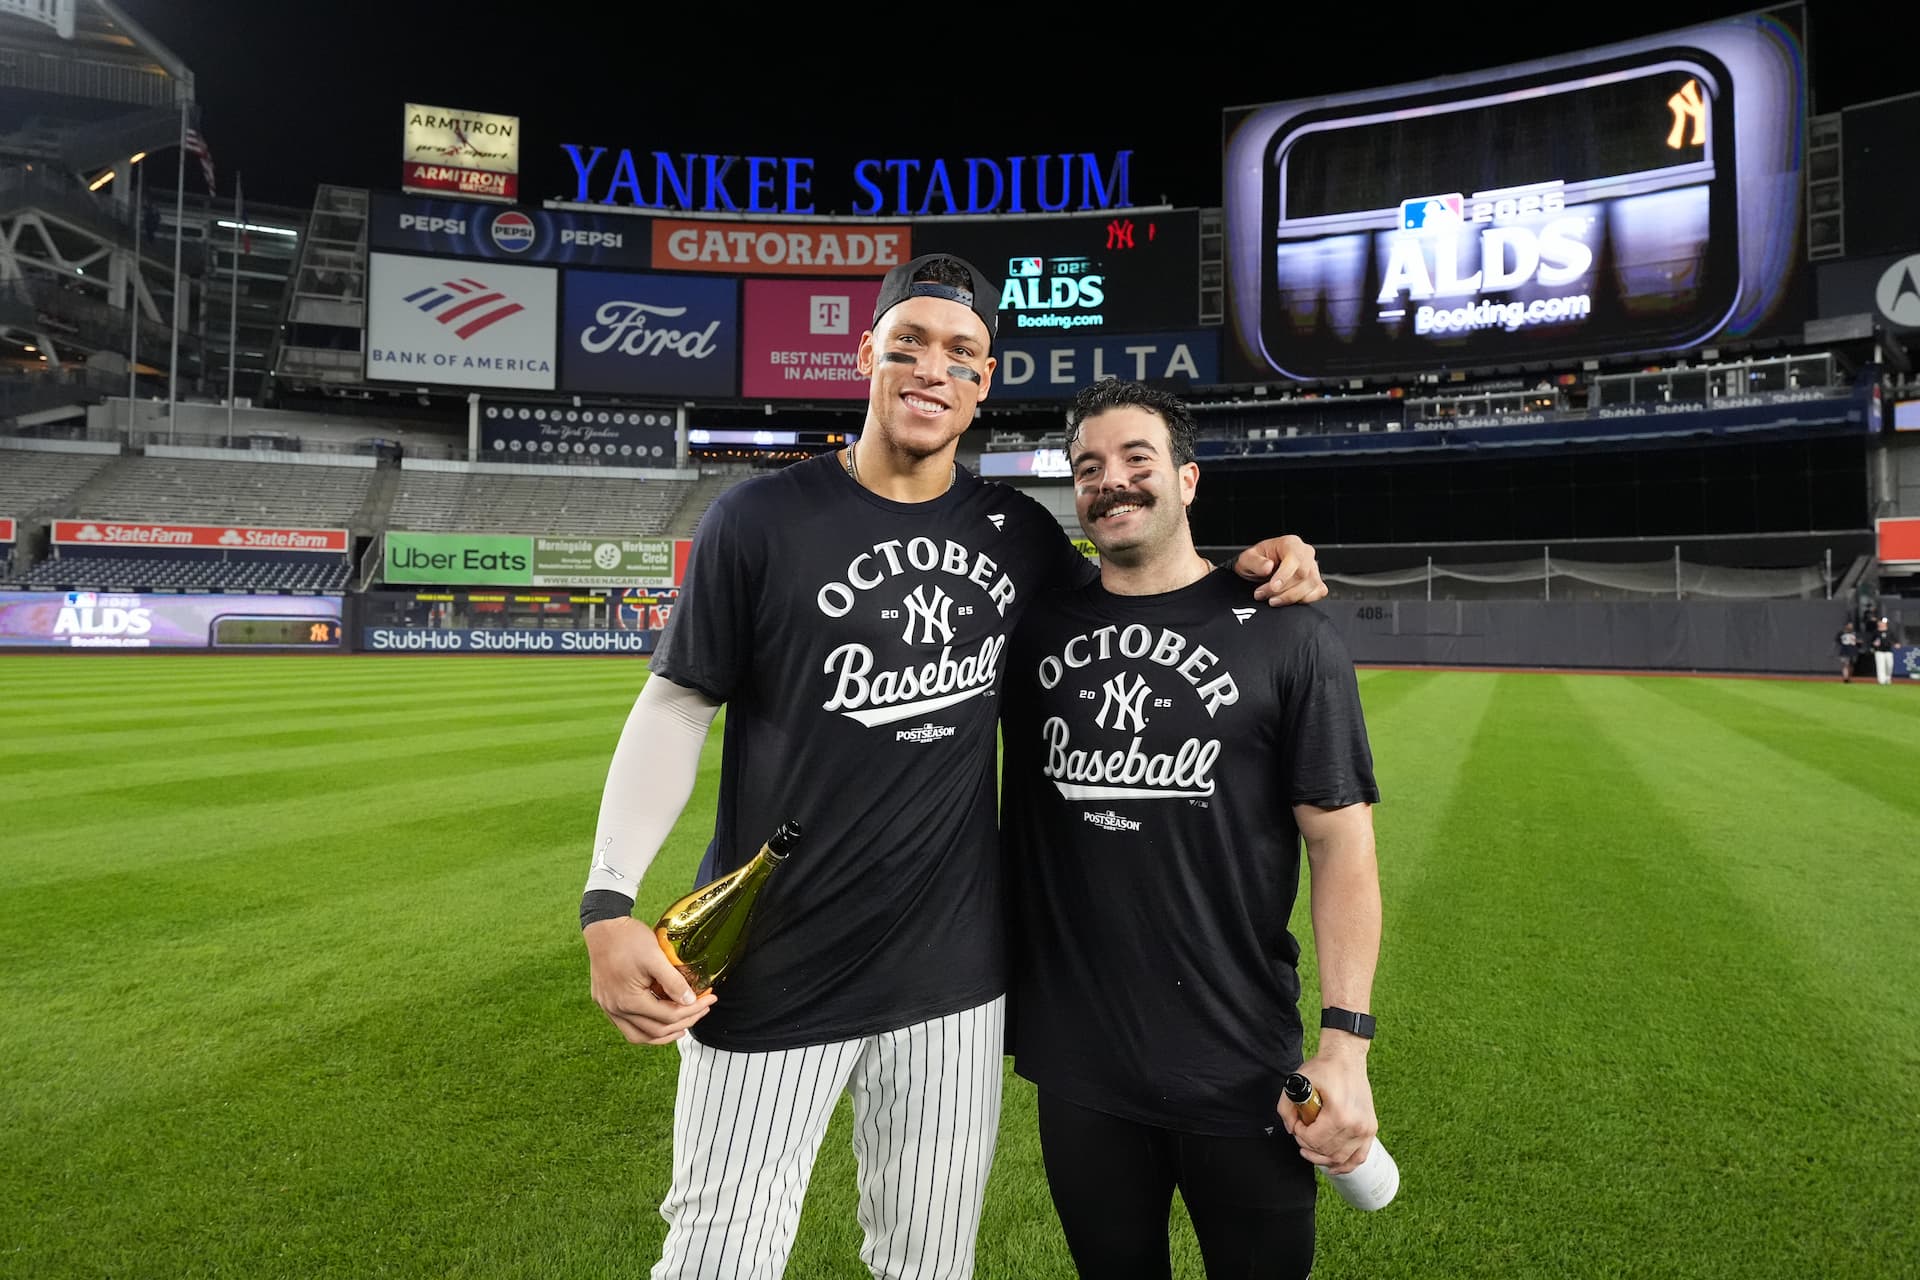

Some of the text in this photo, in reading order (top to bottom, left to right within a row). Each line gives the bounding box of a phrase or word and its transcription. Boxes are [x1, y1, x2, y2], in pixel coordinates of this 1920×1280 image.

[409, 113, 513, 137] ARMITRON
[413, 165, 507, 187] ARMITRON
[559, 144, 1134, 217] YANKEE STADIUM
[400, 213, 466, 235] PEPSI
[494, 226, 533, 240] PEPSI
[560, 230, 623, 248] PEPSI
[668, 228, 899, 267] GATORADE
[1377, 213, 1593, 303] ALDS
[998, 275, 1105, 310] ALDS
[1017, 313, 1103, 329] Booking.com
[1415, 294, 1591, 335] Booking.com
[580, 300, 721, 359] Ford
[372, 349, 551, 373] BANK OF AMERICA
[770, 352, 860, 366] BEST NETW
[1002, 343, 1200, 386] DELTA
[784, 367, 801, 380] IN
[391, 547, 527, 571] Uber Eats
[817, 536, 1016, 618] OCTOBER
[53, 607, 152, 635] ALDS
[881, 584, 974, 645] 20 NY 25
[1355, 606, 1383, 620] 408
[372, 629, 643, 651] StubHub StubHub StubHub
[822, 633, 1006, 712] Baseball
[1038, 623, 1240, 719] OCTOBER
[1079, 671, 1173, 734] 20 NY 25
[896, 726, 956, 742] POSTSEASON
[1042, 716, 1221, 790] Baseball
[1083, 811, 1141, 832] POSTSEASON
